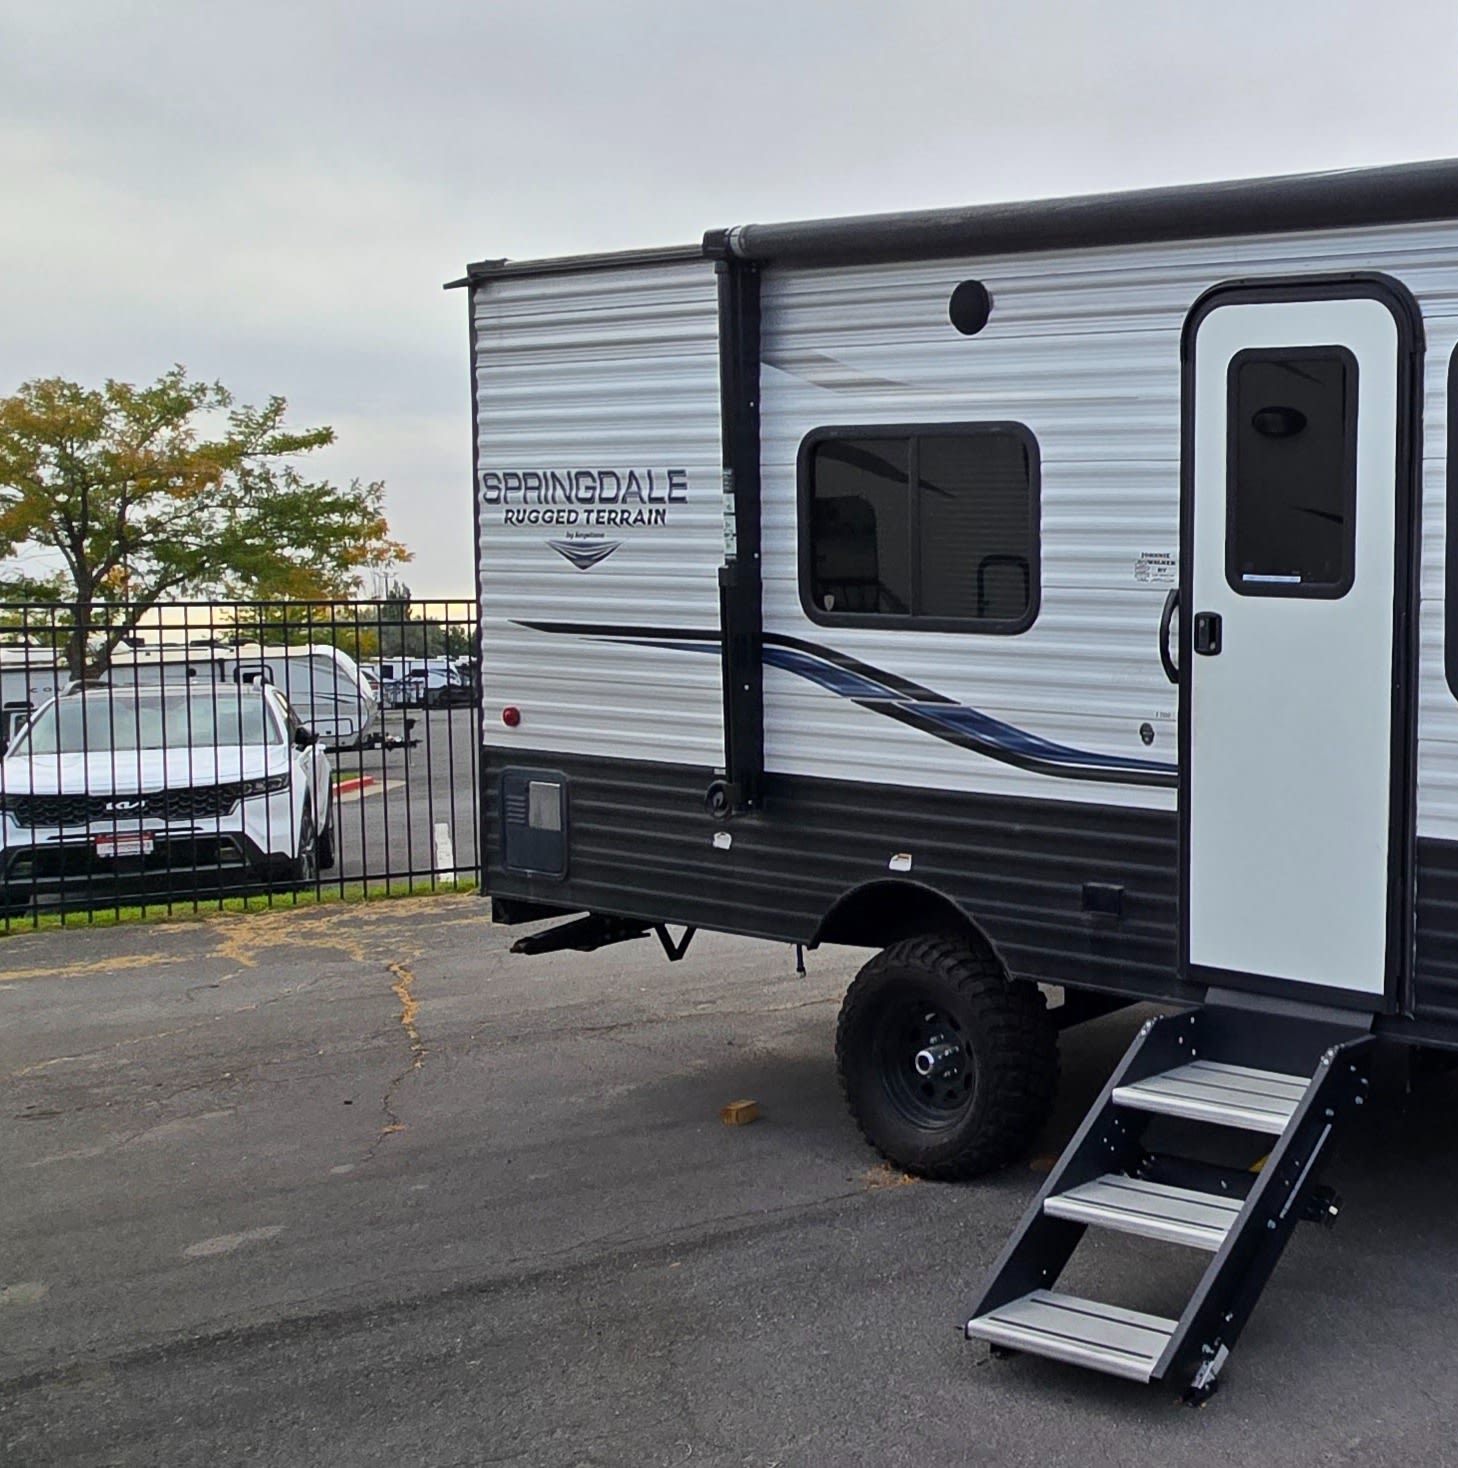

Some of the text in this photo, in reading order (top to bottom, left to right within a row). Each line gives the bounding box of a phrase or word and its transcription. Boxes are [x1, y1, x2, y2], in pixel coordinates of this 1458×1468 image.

[482, 469, 688, 505] SPRINGDALE
[504, 509, 667, 527] RUGGED TERRAIN
